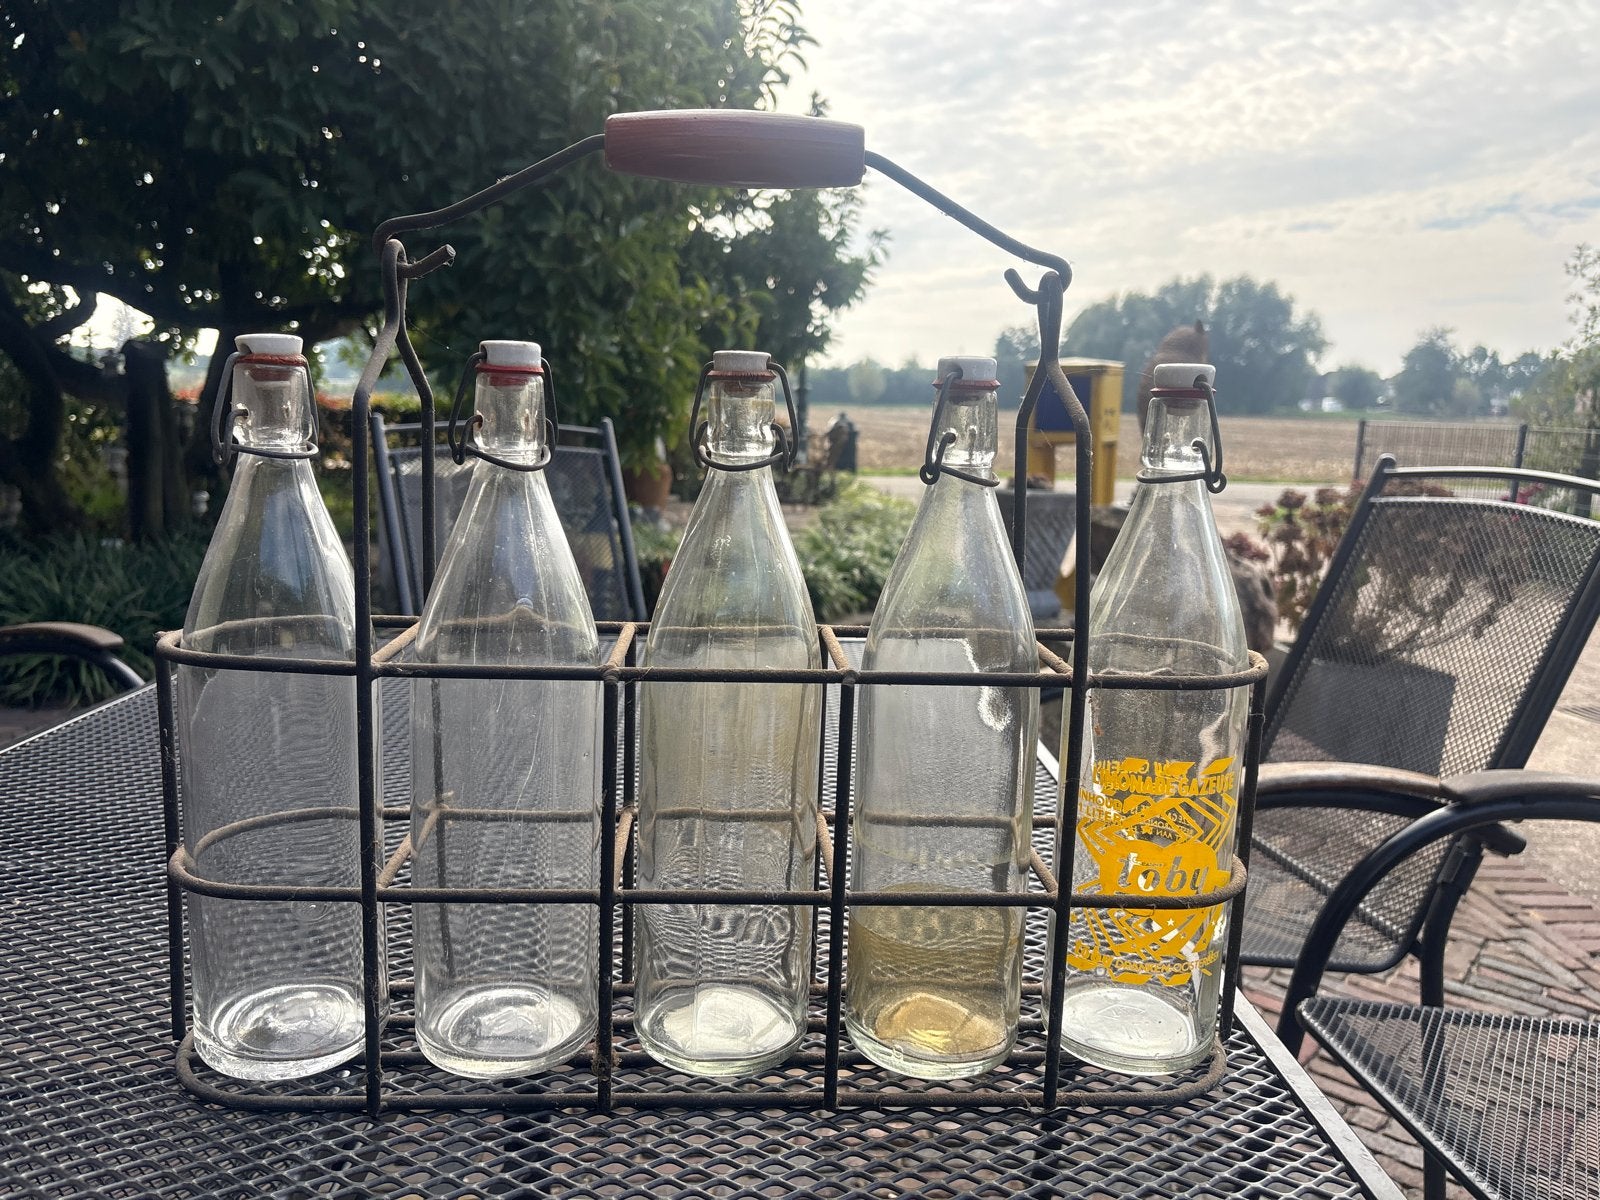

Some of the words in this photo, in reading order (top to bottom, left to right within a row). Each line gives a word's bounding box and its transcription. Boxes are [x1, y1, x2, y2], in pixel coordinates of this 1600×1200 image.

[1092, 768, 1175, 796] LIMONADE
[1178, 772, 1234, 797] GAZEUSE
[1086, 805, 1122, 824] LITER
[1117, 852, 1208, 896] toby
